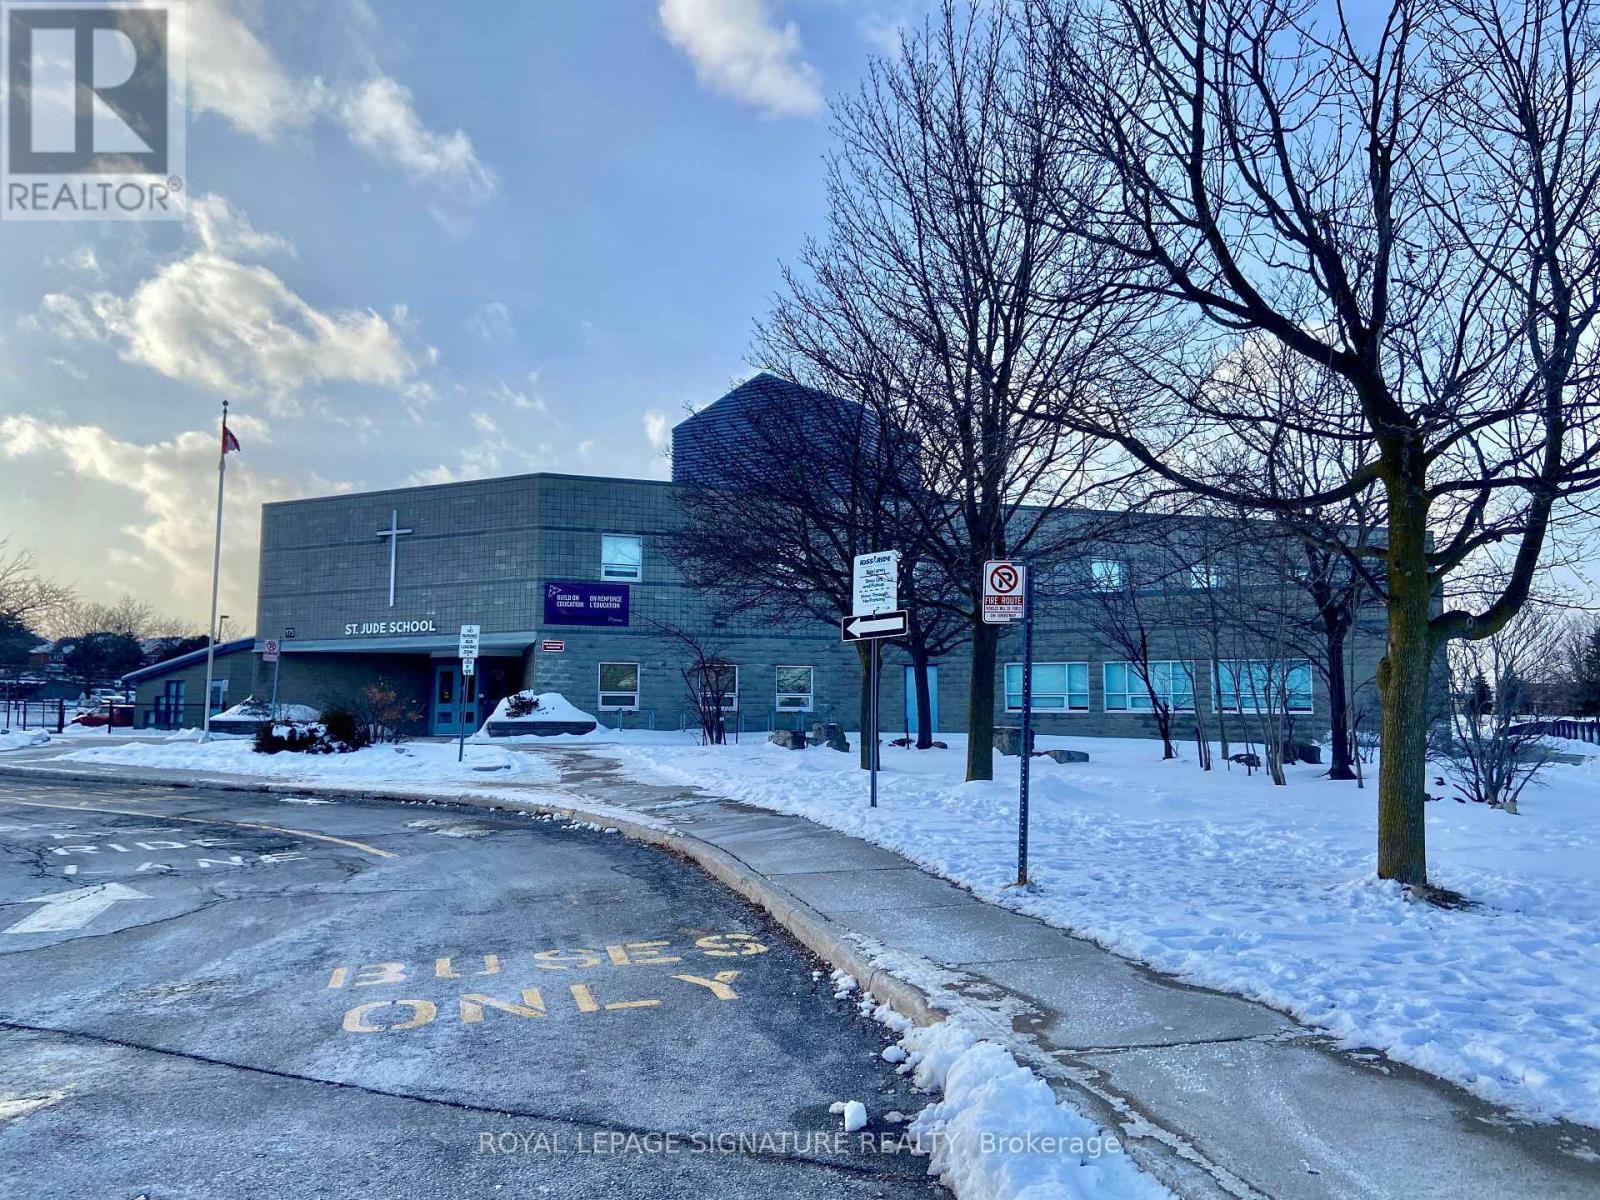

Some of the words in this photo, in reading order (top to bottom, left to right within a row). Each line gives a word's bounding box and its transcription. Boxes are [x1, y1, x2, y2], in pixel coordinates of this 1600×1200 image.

[876, 555, 892, 563] RIDE
[597, 595, 622, 603] RENFORCE
[985, 596, 999, 605] FIRE
[1001, 596, 1022, 605] ROUTE
[345, 623, 359, 635] ST.
[360, 622, 387, 634] JUDE
[389, 620, 436, 633] SCHOOL
[48, 838, 241, 856] RIDE
[64, 852, 307, 875] LANE
[327, 933, 769, 989] BUSES
[343, 970, 741, 1033] ONLY
